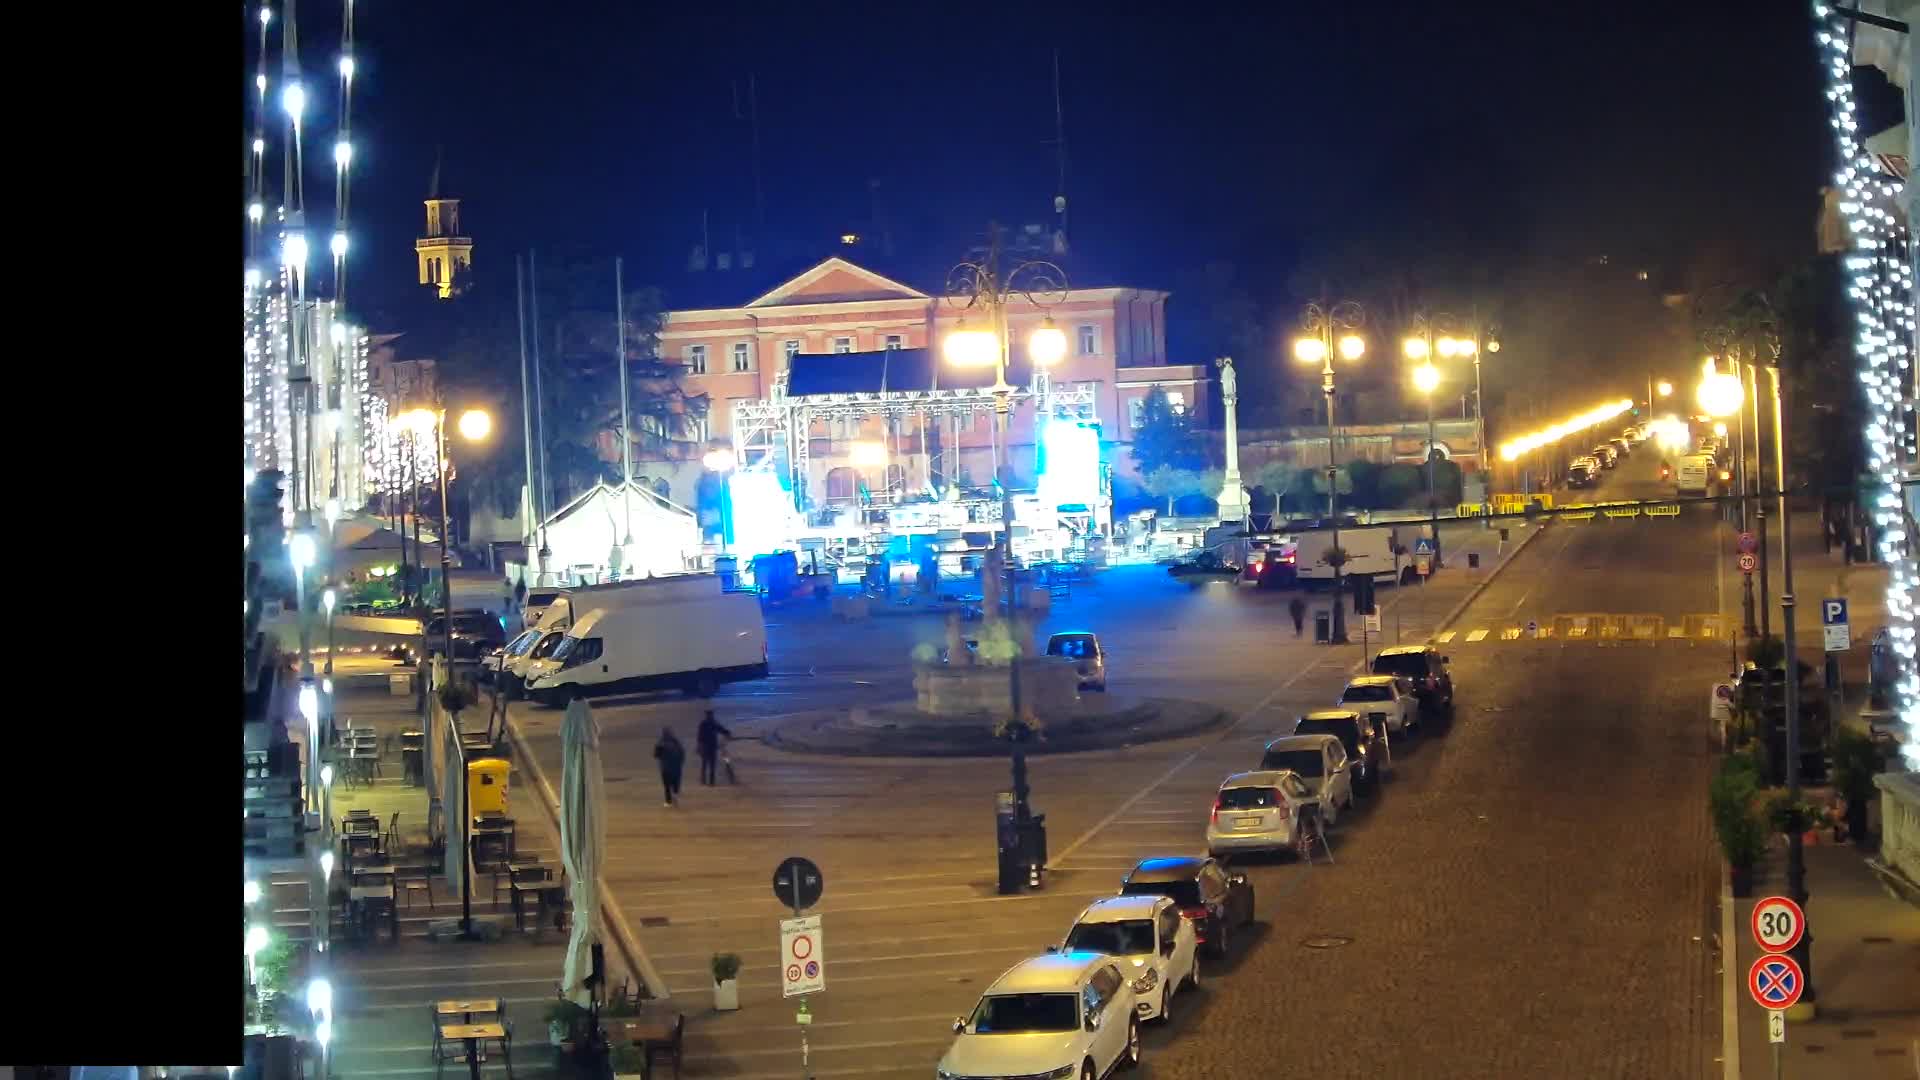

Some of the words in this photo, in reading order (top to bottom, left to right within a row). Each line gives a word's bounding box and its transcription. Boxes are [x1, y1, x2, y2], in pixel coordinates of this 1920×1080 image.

[1743, 558, 1752, 567] 20
[1828, 602, 1842, 622] P
[1762, 912, 1791, 937] 30
